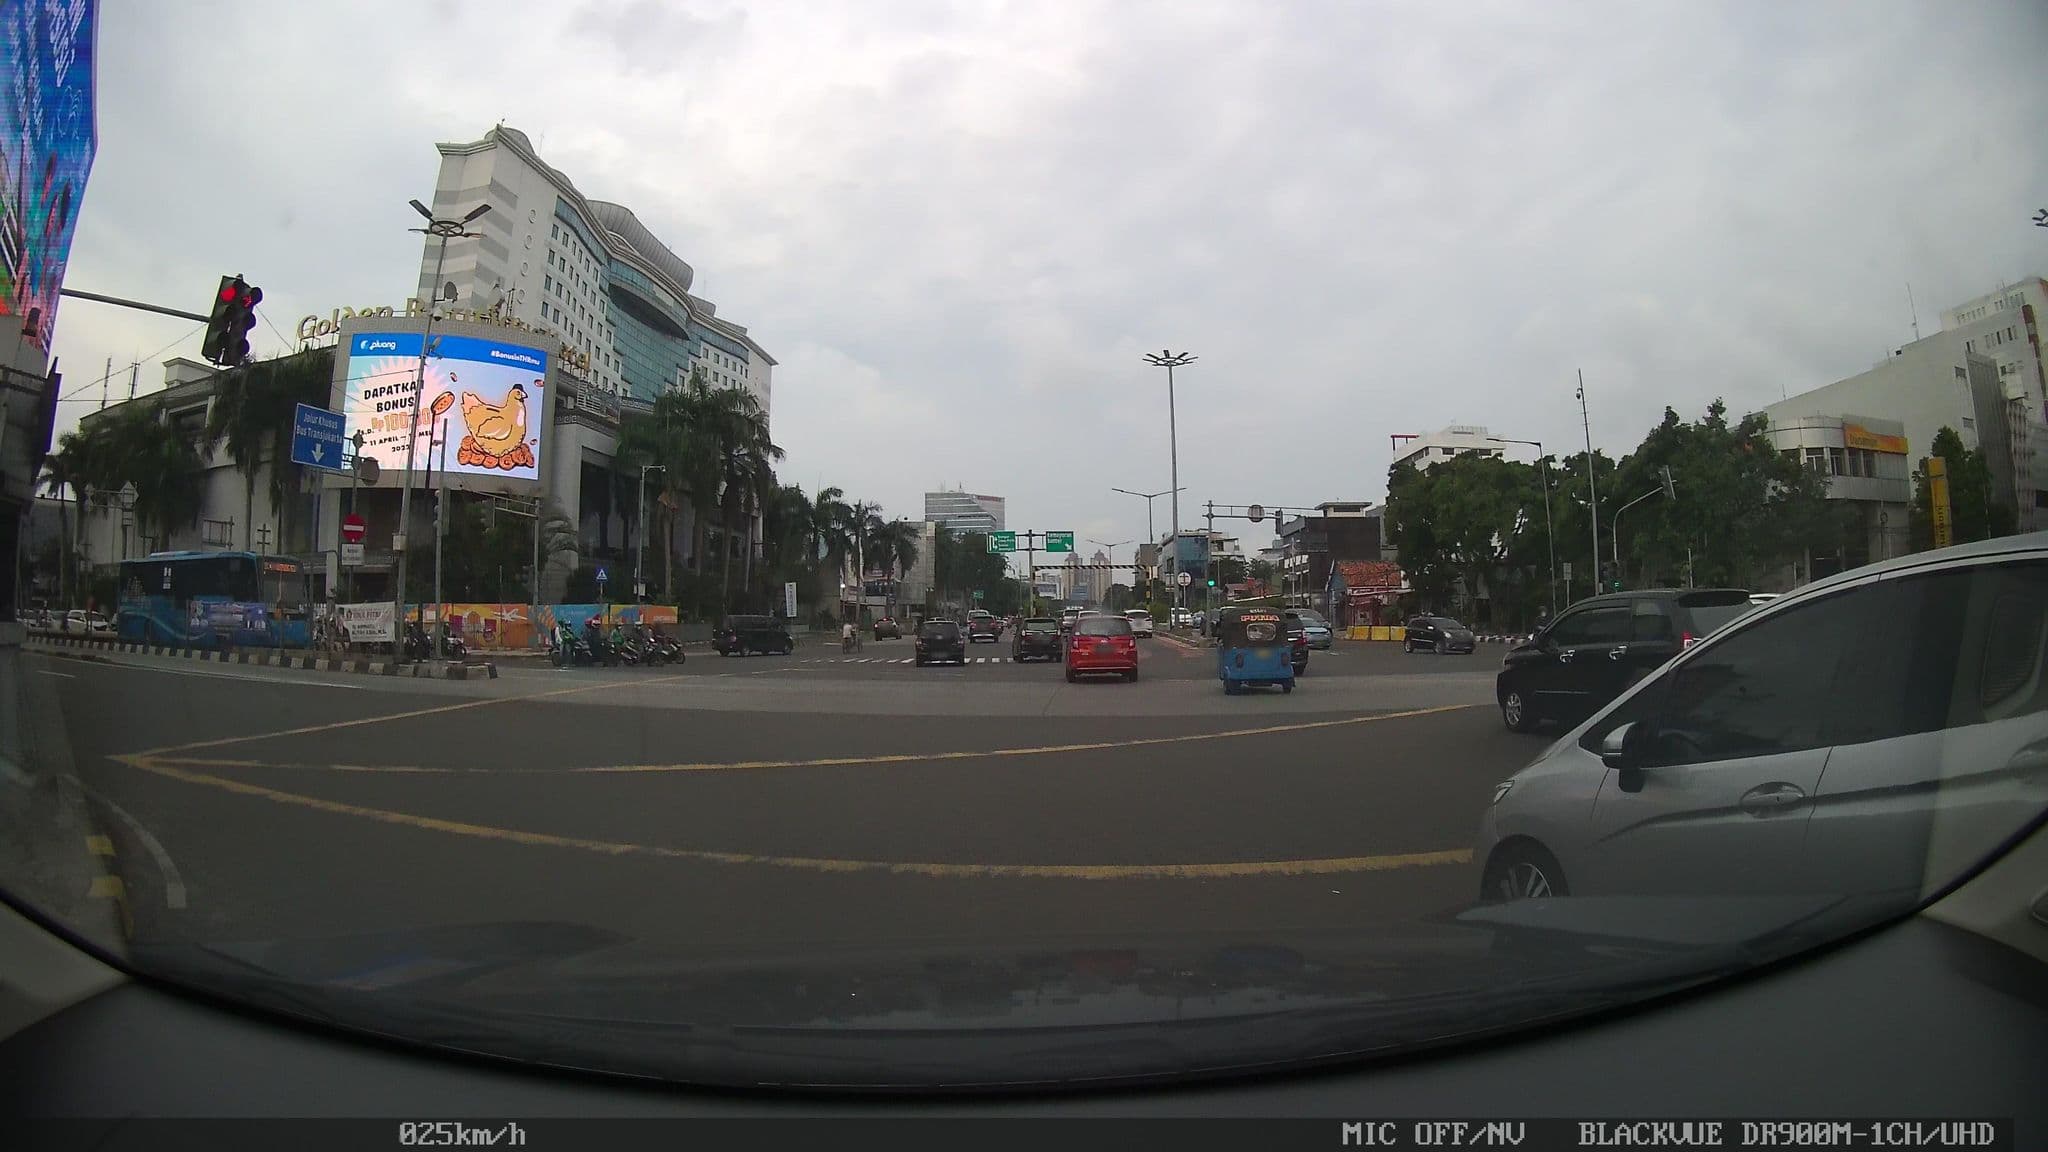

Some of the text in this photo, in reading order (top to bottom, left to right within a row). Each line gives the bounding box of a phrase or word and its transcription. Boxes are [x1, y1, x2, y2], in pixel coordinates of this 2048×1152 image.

[364, 380, 423, 400] DAPATKA
[376, 397, 415, 413] BONUS
[378, 436, 399, 444] APRIL
